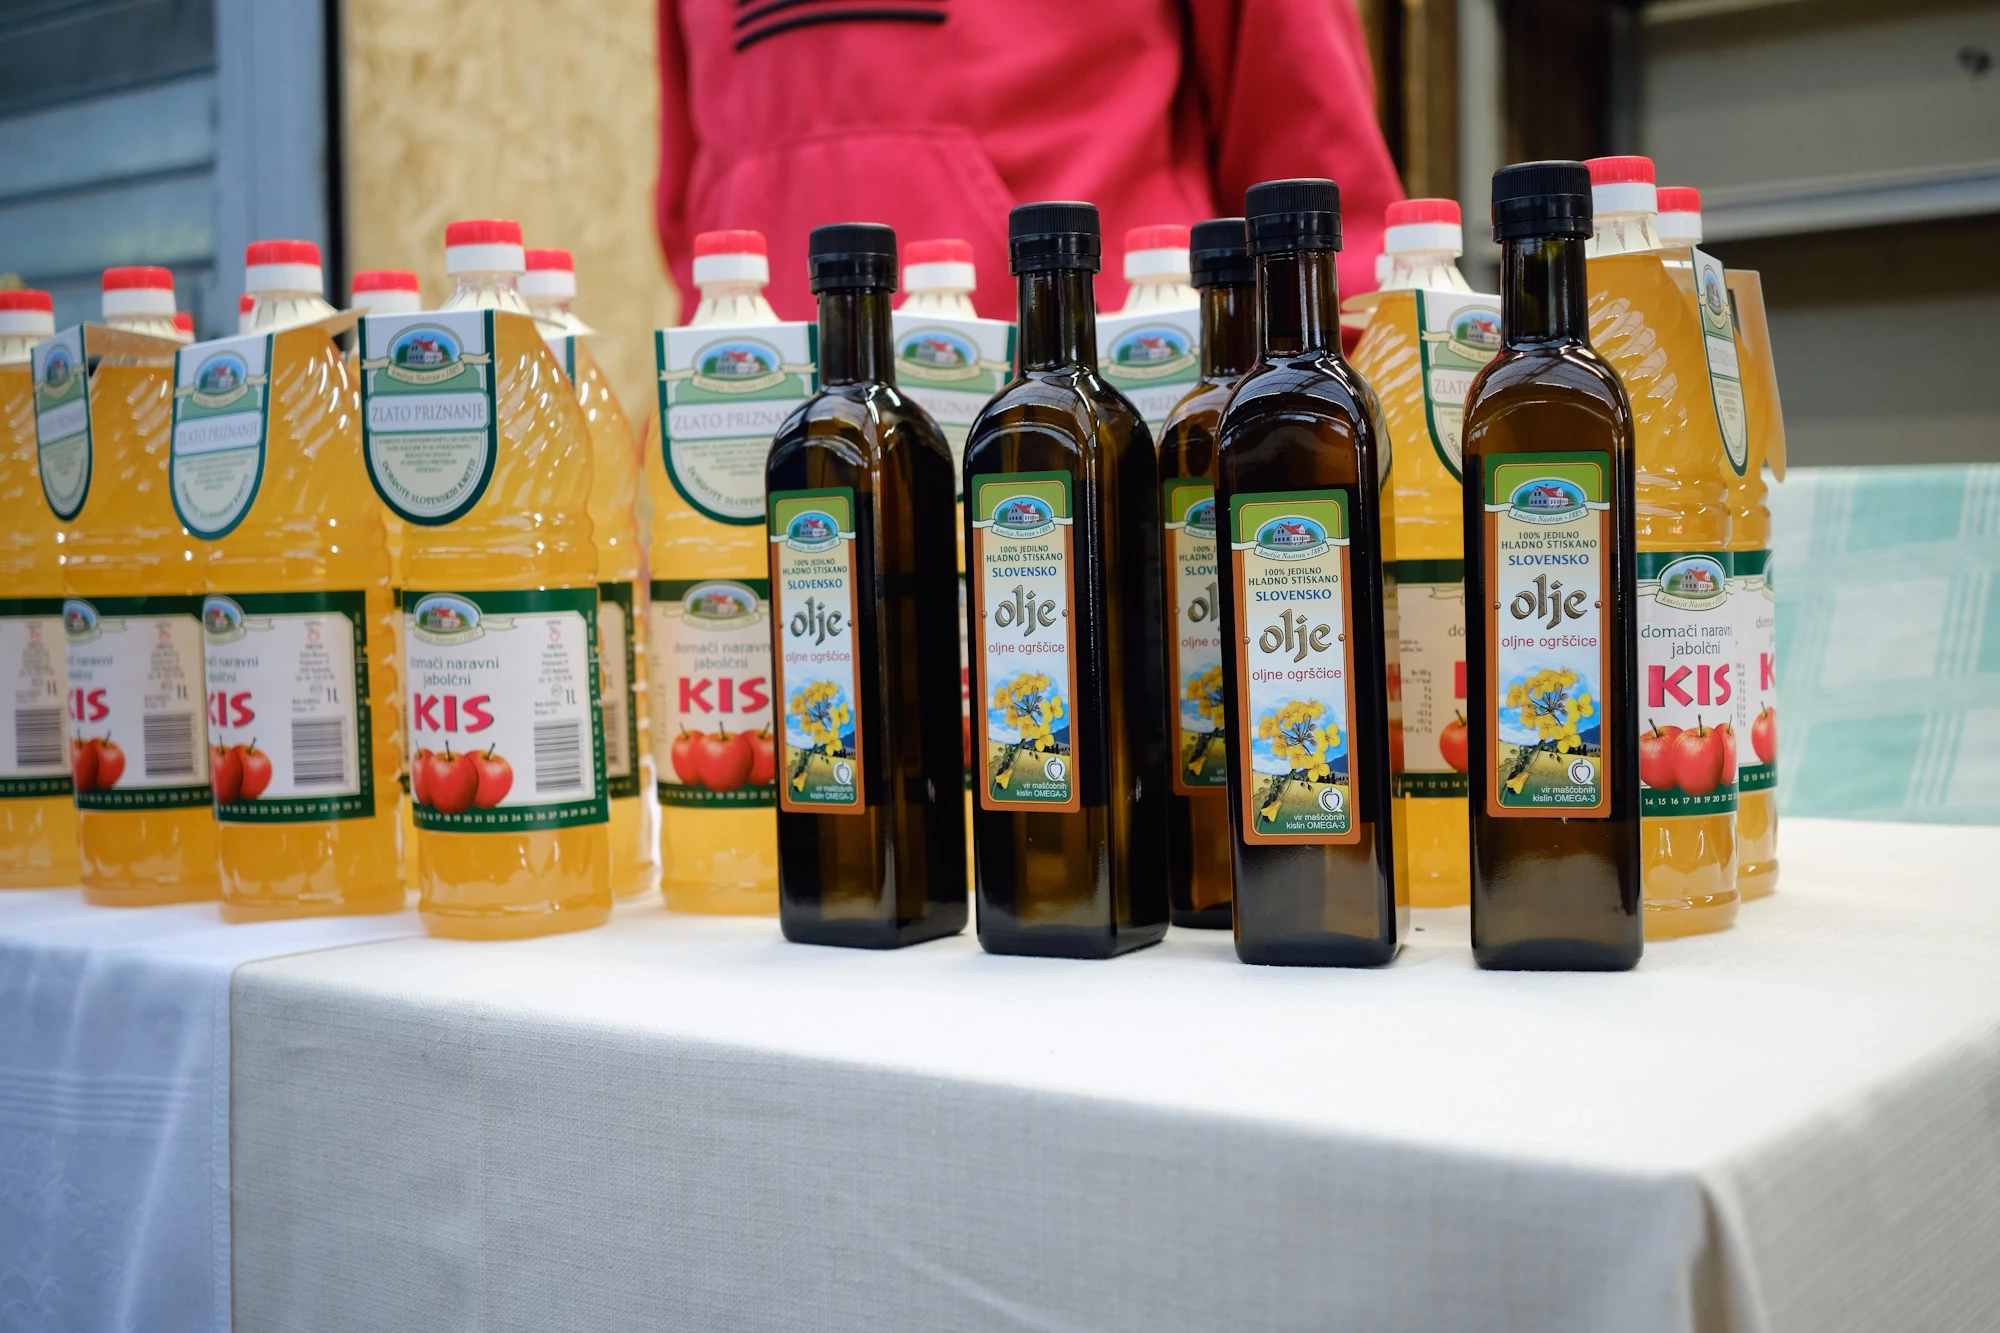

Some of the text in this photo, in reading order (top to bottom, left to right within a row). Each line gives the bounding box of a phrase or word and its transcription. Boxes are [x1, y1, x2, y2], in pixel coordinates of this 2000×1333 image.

[372, 403, 484, 423] ZLATO PRIZNANJE
[672, 414, 721, 431] ZLATO
[1513, 510, 1537, 522] kmetija
[1568, 510, 1583, 519] 1885
[1519, 531, 1580, 540] 100% JEDILNO
[1020, 545, 1049, 553] JEDILNO
[1501, 539, 1597, 549] HLADNO STISKANO
[986, 552, 1063, 562] HLADNO STISKANO
[1179, 553, 1214, 562] HLADNO
[1259, 548, 1281, 559] kmetija
[1310, 546, 1324, 556] 1885
[811, 558, 835, 566] JEDILNO
[1508, 554, 1589, 566] SLOVENSKO
[783, 565, 847, 575] HLADNO STISKANO
[992, 566, 1057, 577] SLOVENSKO
[1185, 565, 1219, 576] SLOVE
[1264, 567, 1322, 576] 100% JEDILNO
[788, 578, 842, 590] SLOVENSKO
[1248, 575, 1339, 586] HLADNO STISKANO
[1256, 589, 1332, 602] SLOVENSKO
[1510, 573, 1587, 630] olje
[995, 584, 1056, 637] olje
[791, 596, 843, 647] olje
[1259, 608, 1332, 663] olje
[1641, 624, 1697, 639] domači
[988, 641, 1065, 656] oljne ogrščice
[1181, 637, 1209, 650] oljne
[1502, 635, 1597, 650] oljne ogrščice
[1670, 640, 1721, 659] jabolčni
[446, 656, 499, 670] naravni
[785, 650, 850, 664] oljne ogrščice
[423, 672, 472, 689] jabolčni
[1252, 667, 1342, 683] oljne ogrščice
[1648, 663, 1731, 707] KIS
[678, 677, 769, 714] KIS
[413, 692, 494, 734] KIS
[1034, 790, 1068, 798] OMEGA-3
[1555, 794, 1596, 802] OMEGA-3
[1645, 798, 1654, 806] 14
[1658, 798, 1666, 806] 15
[1671, 797, 1679, 805] 16
[1683, 797, 1690, 805] 17
[1694, 796, 1701, 804] 18
[1713, 795, 1720, 803] 20
[1304, 813, 1345, 821] maščobnih
[1306, 821, 1345, 829] OMEGA-3
